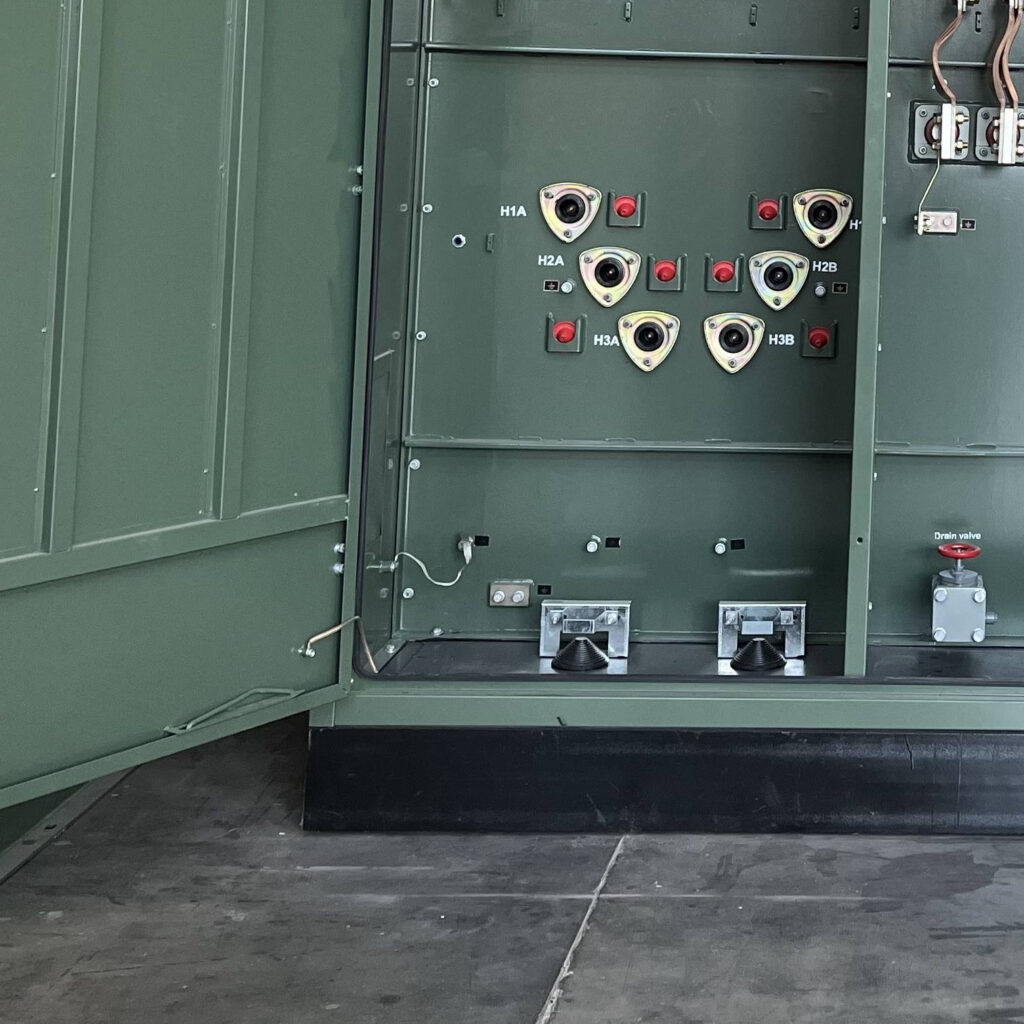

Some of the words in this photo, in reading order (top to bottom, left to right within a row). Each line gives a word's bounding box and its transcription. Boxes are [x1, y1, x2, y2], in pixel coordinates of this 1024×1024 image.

[500, 205, 527, 217] H1A
[537, 255, 565, 266] H2A
[812, 261, 838, 272] H2B
[593, 335, 620, 346] H3A
[768, 334, 795, 345] H3B
[934, 531, 957, 540] Drain
[958, 531, 982, 540] valve
